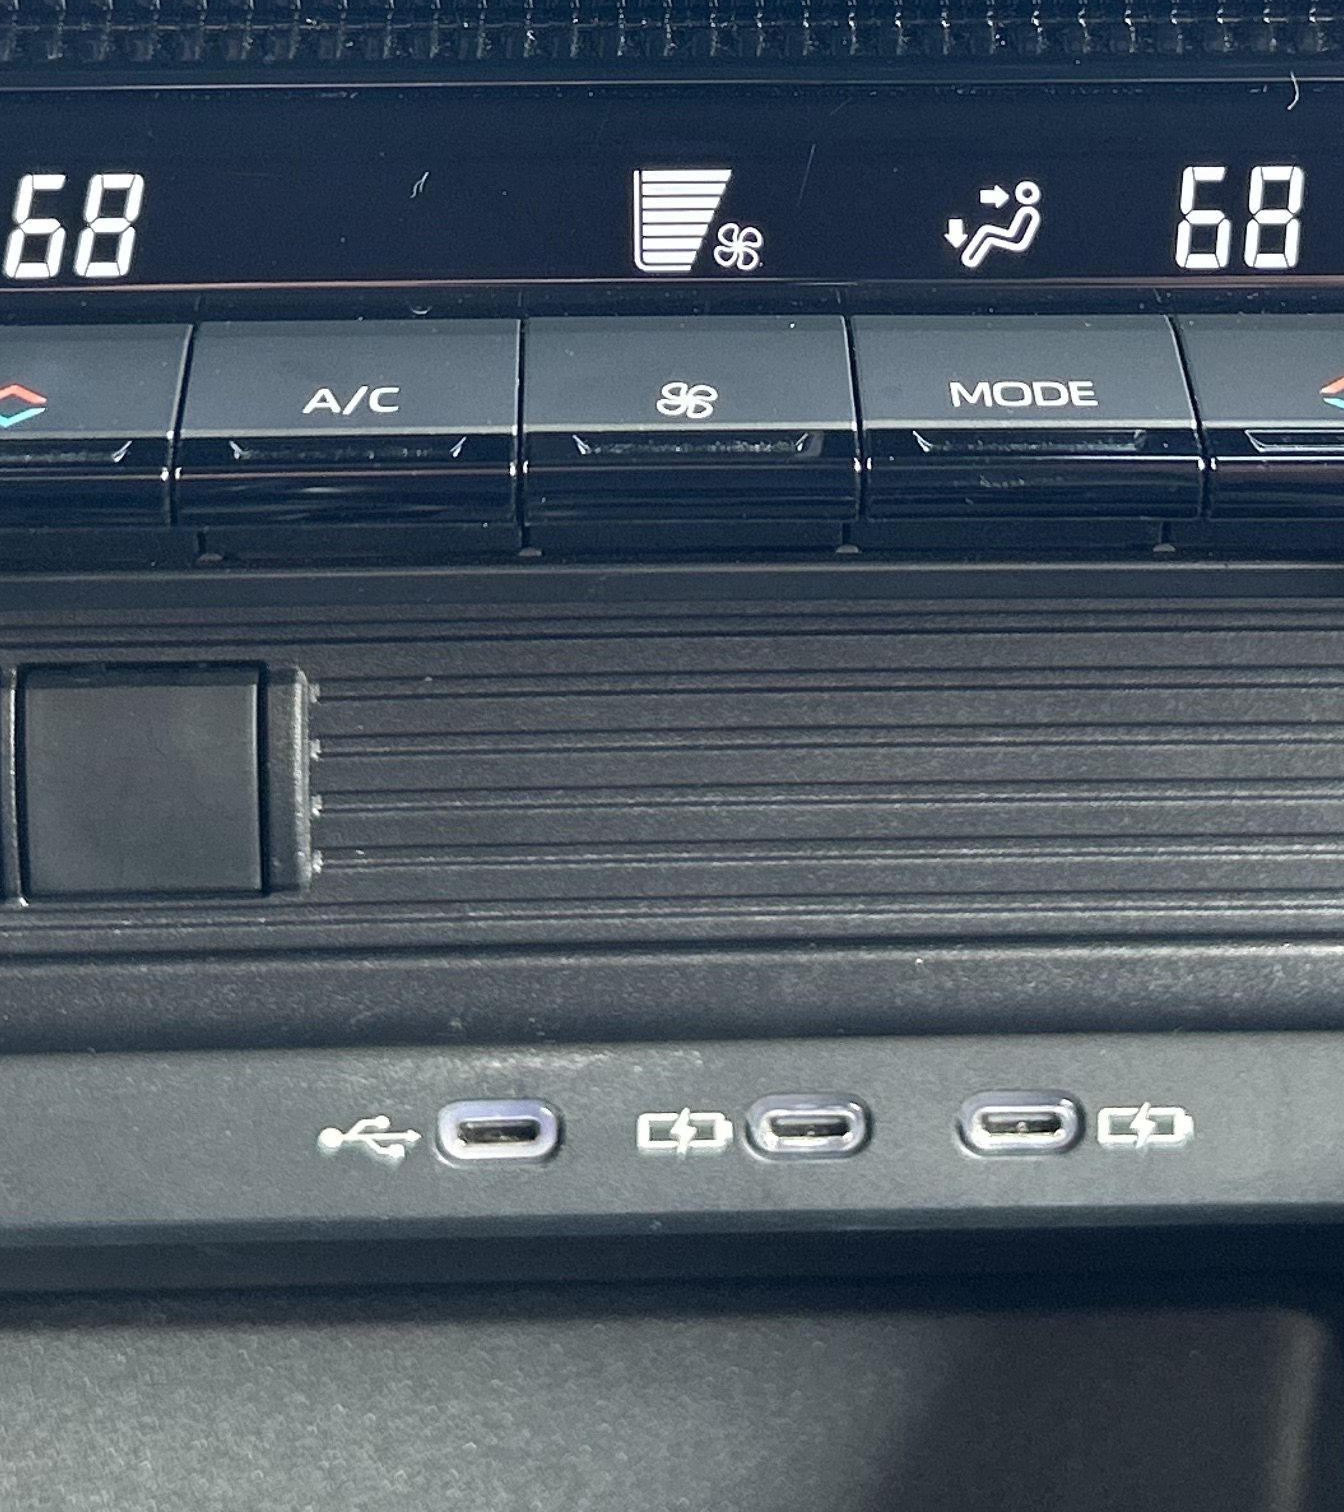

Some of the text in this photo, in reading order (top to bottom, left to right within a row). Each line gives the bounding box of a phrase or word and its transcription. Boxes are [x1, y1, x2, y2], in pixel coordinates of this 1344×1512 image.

[2, 172, 145, 280] 68
[1175, 165, 1304, 273] 68
[302, 385, 401, 415] A/C
[949, 379, 1099, 409] MODE
